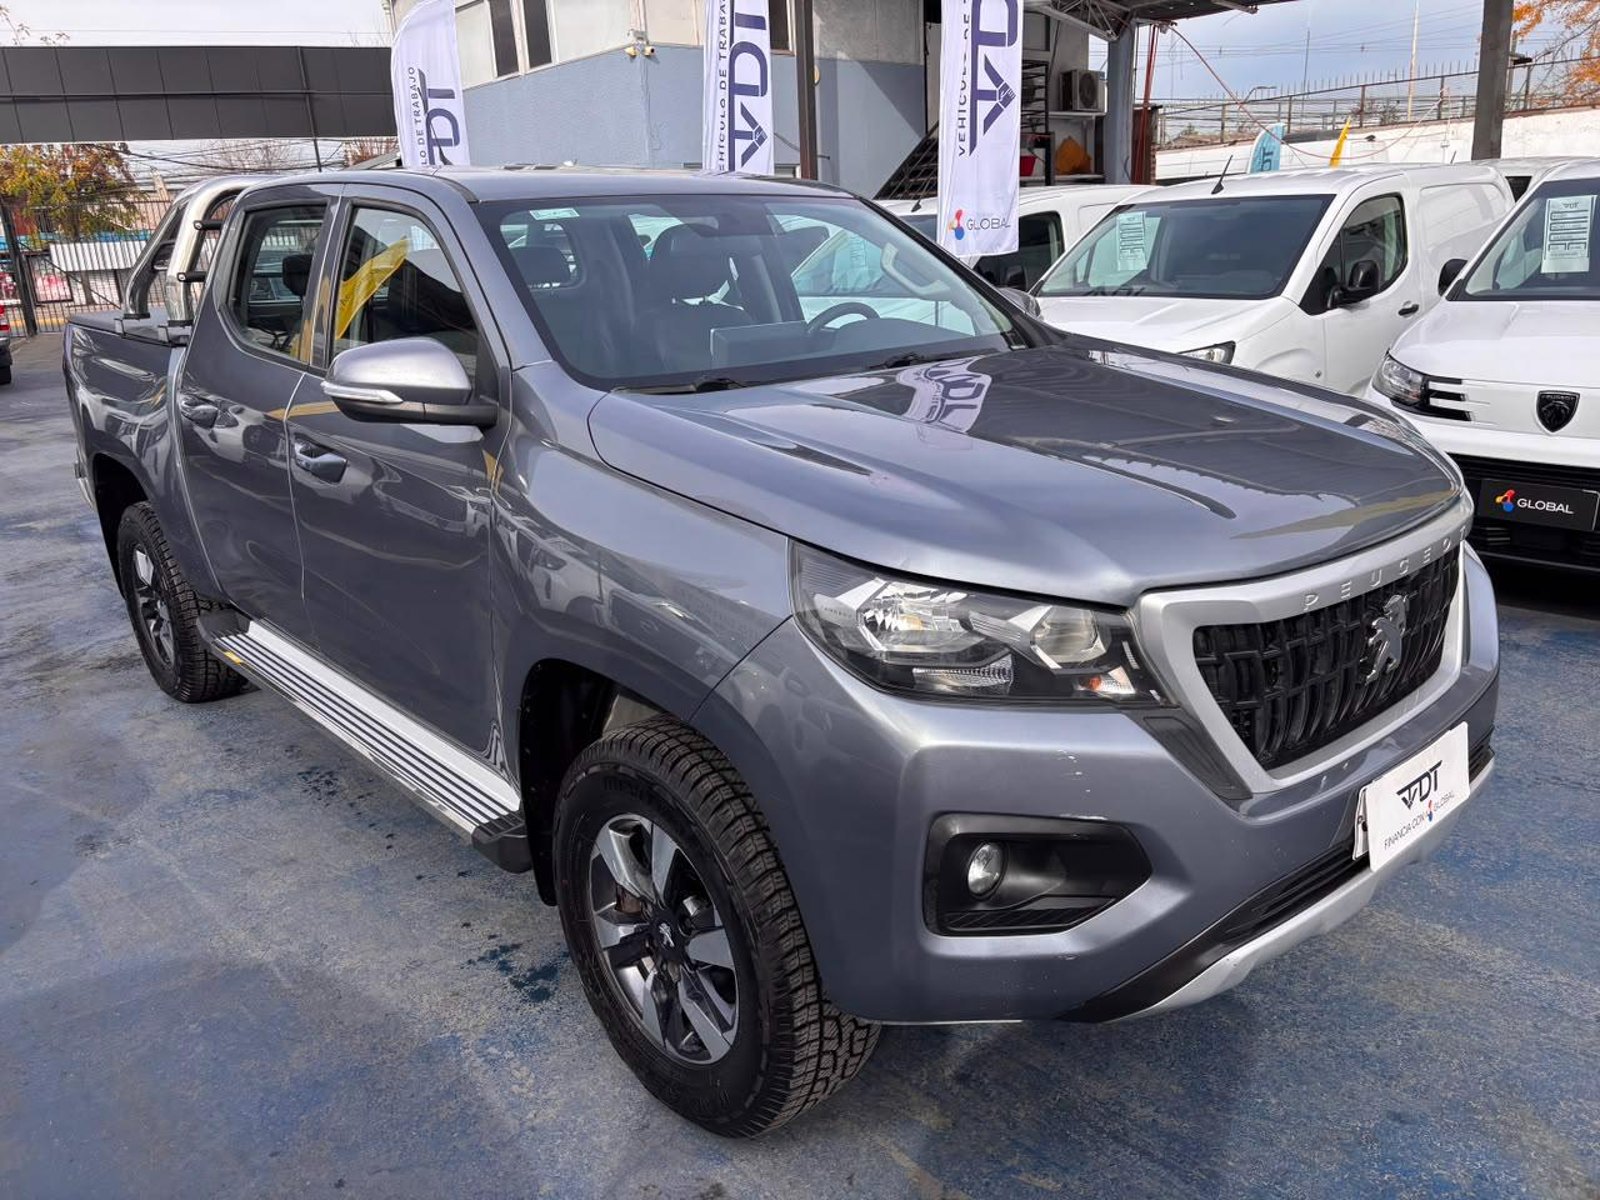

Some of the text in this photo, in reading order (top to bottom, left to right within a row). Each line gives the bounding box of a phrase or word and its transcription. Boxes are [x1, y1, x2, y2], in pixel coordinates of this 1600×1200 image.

[719, 69, 727, 91] DE
[408, 66, 423, 124] TRABAJO
[416, 129, 425, 146] DE
[966, 217, 1011, 231] GLOBAL
[1516, 497, 1575, 514] GLOBAL
[1303, 525, 1467, 611] PEUGEOT
[1396, 759, 1443, 811] VDT
[1384, 823, 1412, 851] FINANCIA
